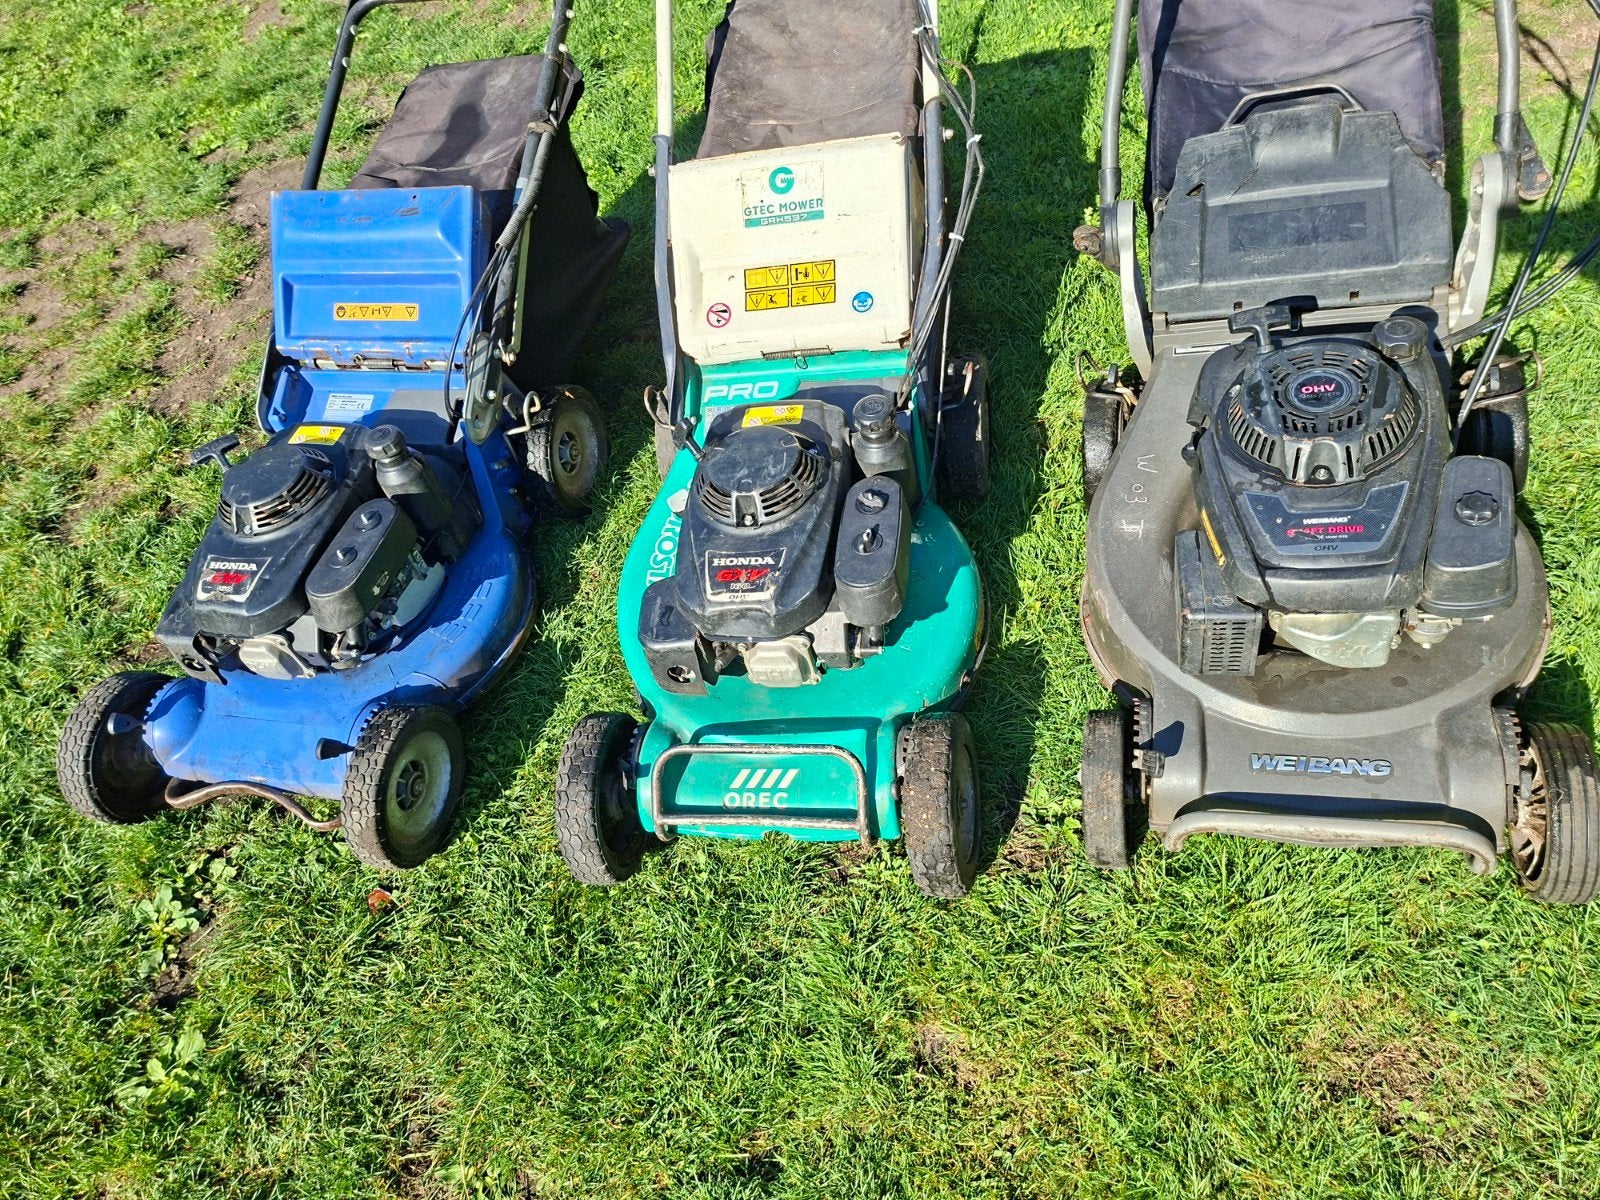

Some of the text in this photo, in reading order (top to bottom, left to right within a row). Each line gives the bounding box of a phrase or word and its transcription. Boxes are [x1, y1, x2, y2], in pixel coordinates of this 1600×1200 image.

[744, 198, 824, 216] GTEC MOWER
[760, 213, 808, 225] GRH537
[703, 381, 779, 403] PRO
[1301, 383, 1336, 394] OHV
[1286, 527, 1325, 537] SAFT
[1328, 525, 1364, 533] DRIVE
[208, 561, 258, 571] HONDA
[712, 556, 775, 567] HONDA
[716, 567, 771, 582] GXV
[1250, 753, 1392, 776] WEIBANG
[723, 791, 788, 809] OREC
